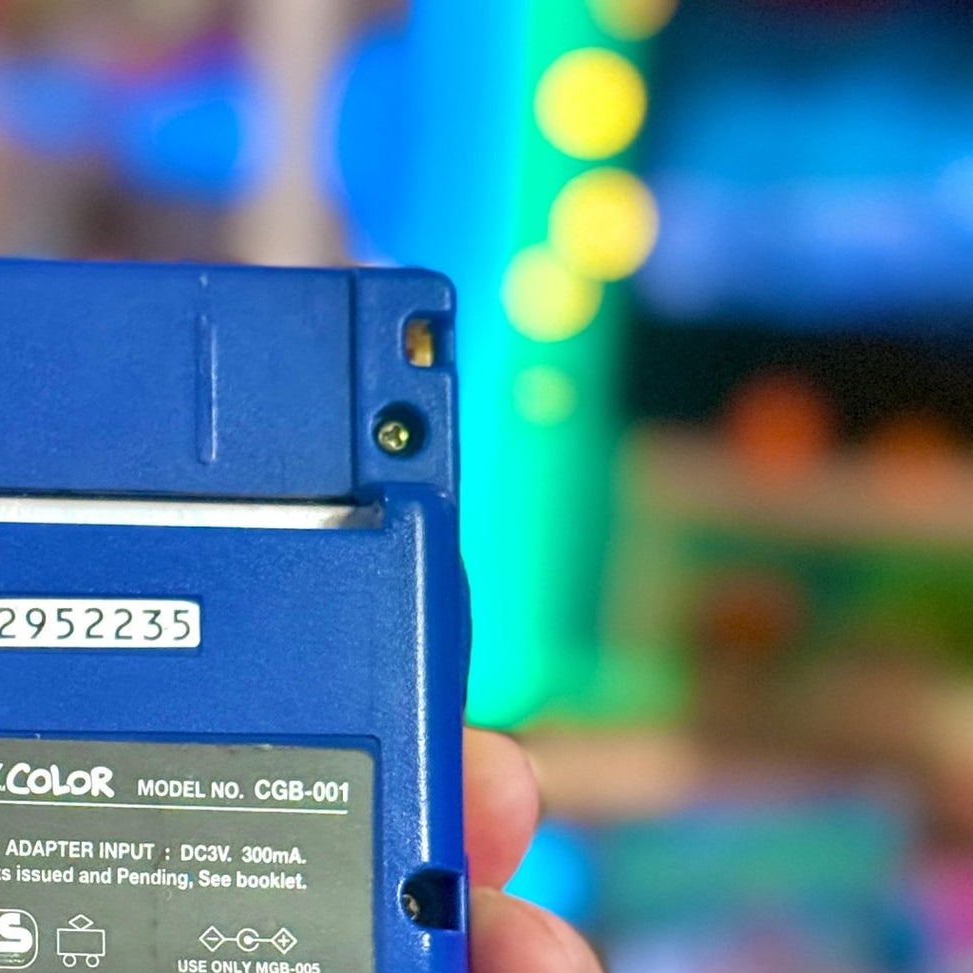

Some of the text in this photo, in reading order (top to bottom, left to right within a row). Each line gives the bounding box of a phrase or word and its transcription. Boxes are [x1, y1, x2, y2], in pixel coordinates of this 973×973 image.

[6, 762, 115, 798] COLOR
[137, 779, 349, 802] MODEL NO. CGB-001
[5, 839, 94, 859] ADAPTER
[99, 842, 155, 860] INPUT
[180, 845, 232, 863] DC3V.
[241, 847, 307, 865] 300mA.
[16, 865, 74, 883] issued
[78, 868, 112, 885] and
[117, 869, 194, 890] Pending,
[198, 870, 232, 888] See
[236, 871, 308, 890] booklet.
[178, 960, 207, 973] USE
